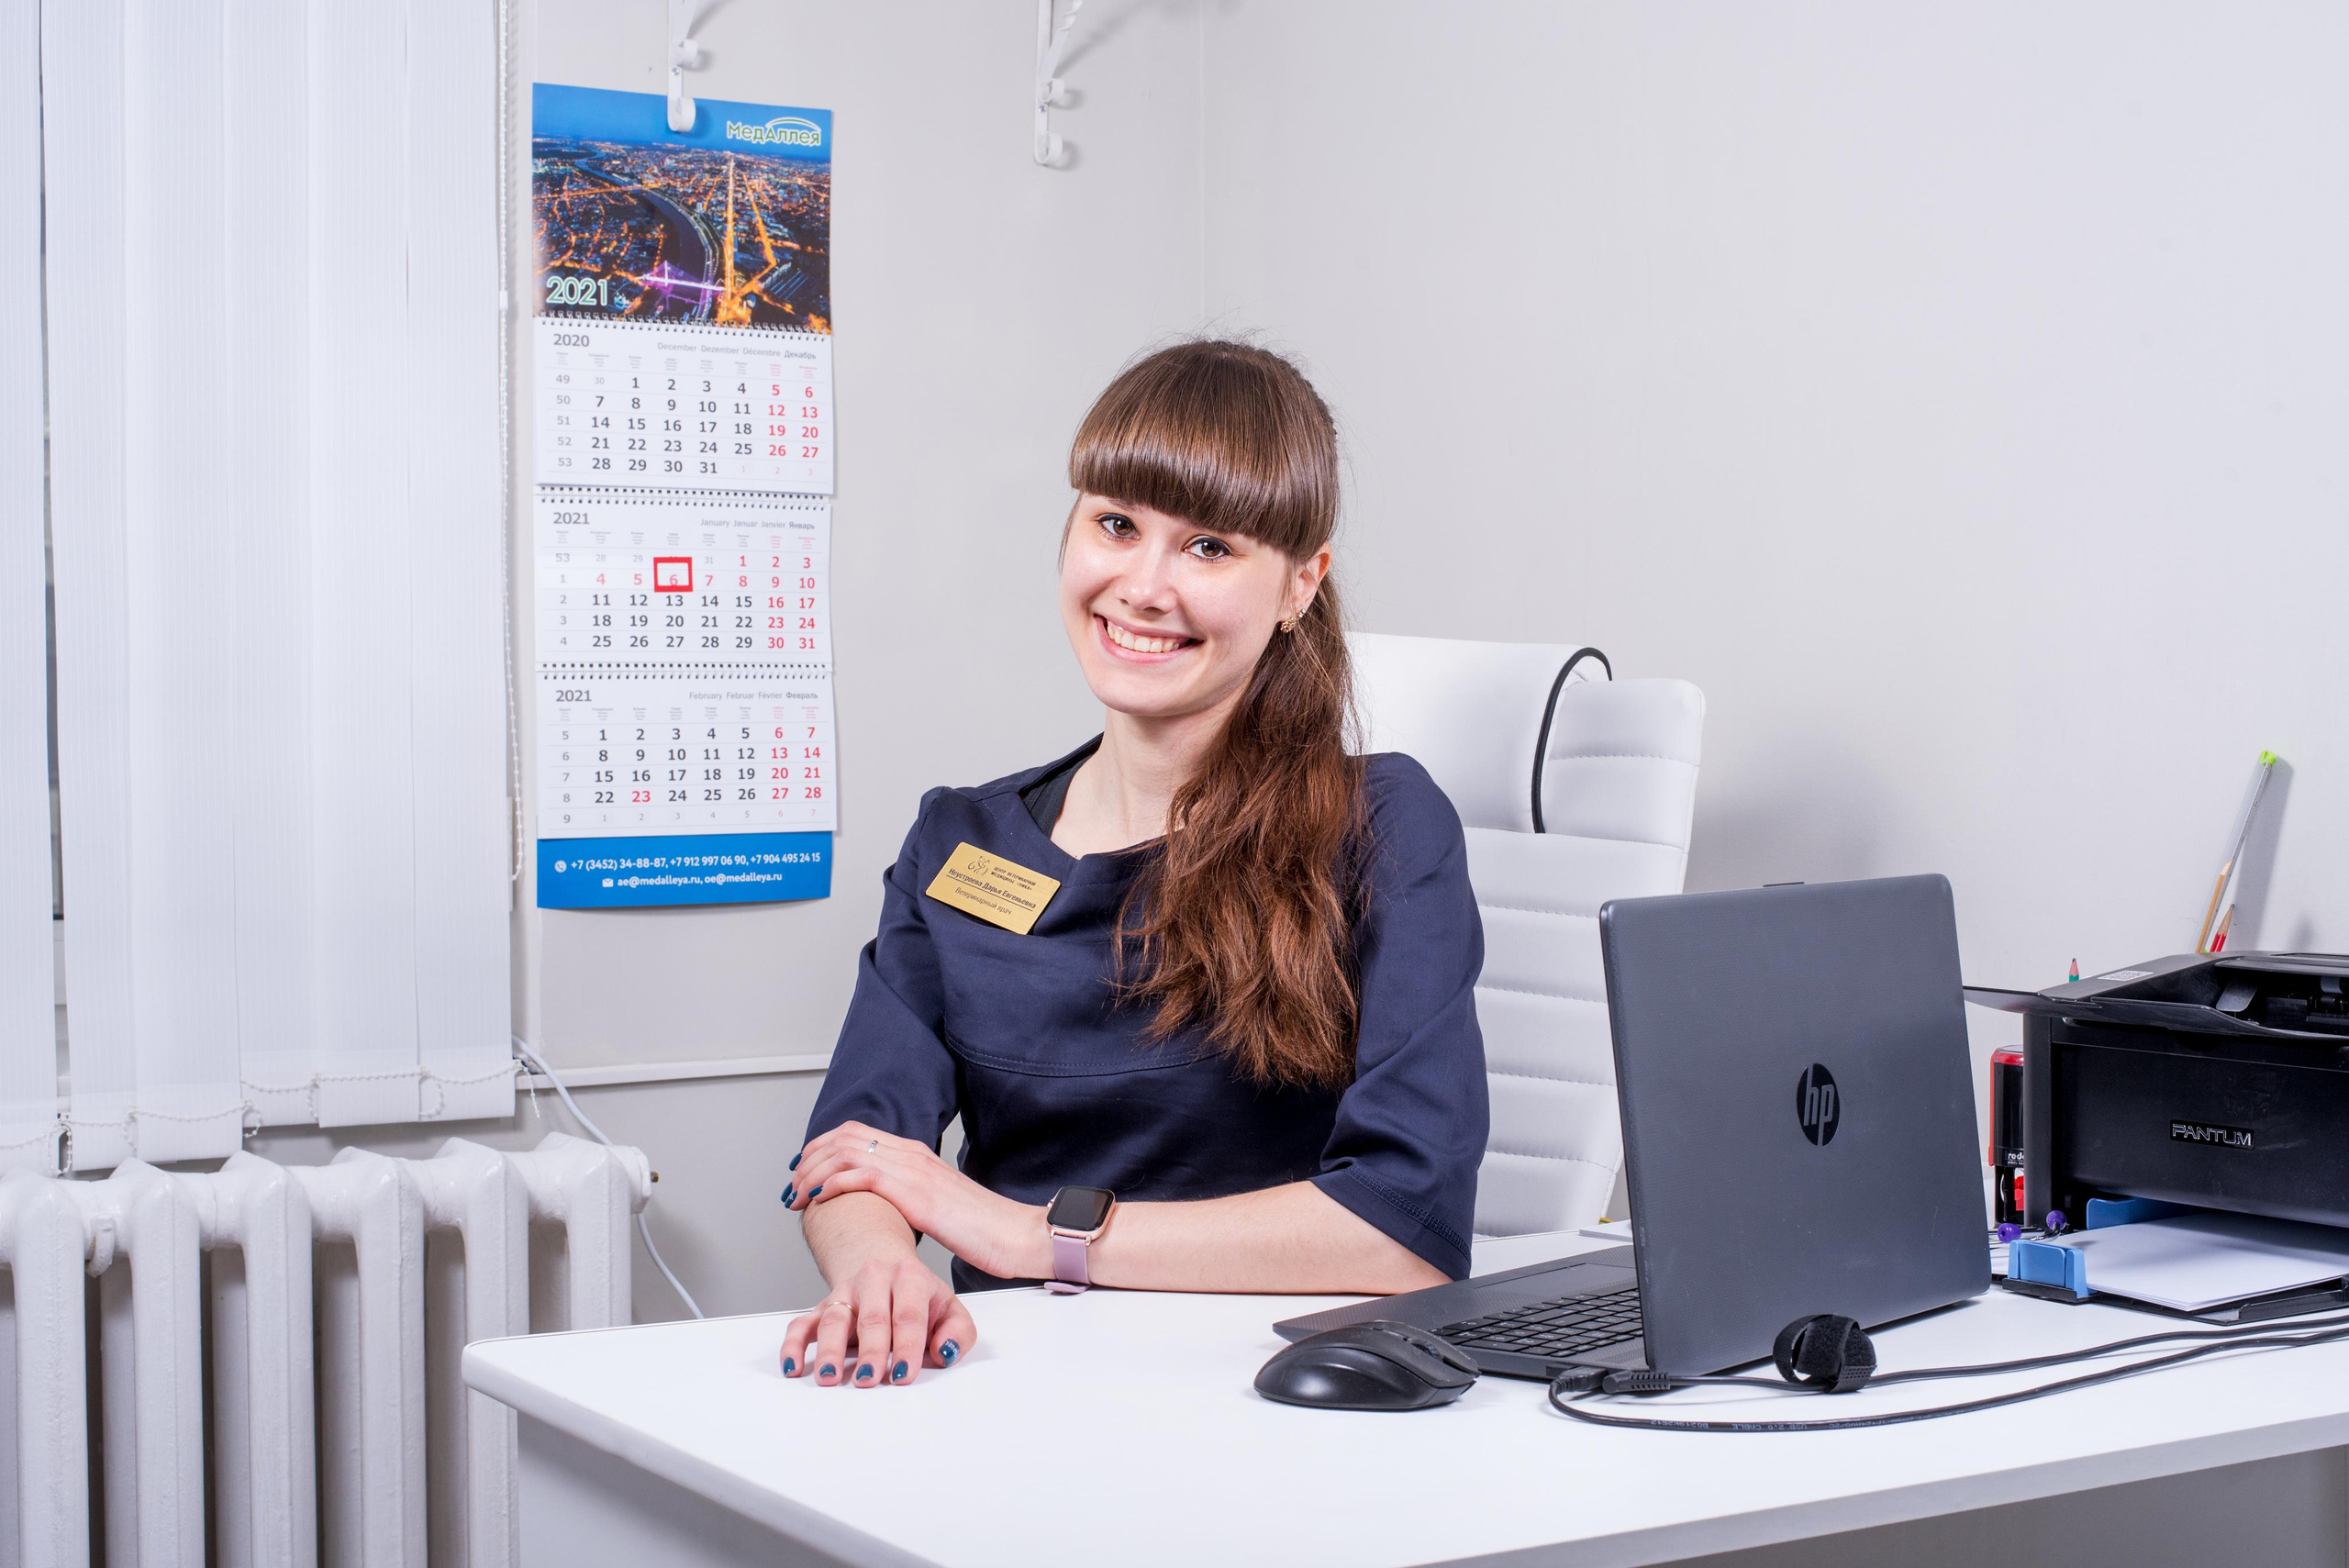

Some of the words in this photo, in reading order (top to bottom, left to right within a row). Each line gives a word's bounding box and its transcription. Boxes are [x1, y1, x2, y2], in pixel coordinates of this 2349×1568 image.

[727, 120, 821, 146] МедАллея
[546, 275, 607, 306] 2021
[553, 333, 590, 348] 2020
[657, 342, 697, 352] December
[700, 344, 740, 355] Dezember
[742, 347, 781, 358] Décembre
[784, 350, 817, 361] Декабрь
[631, 376, 640, 389] 1
[667, 378, 676, 391] 2
[702, 380, 712, 393] 3
[737, 382, 747, 395] 4
[772, 384, 780, 396] 5
[805, 386, 814, 399] 6
[556, 394, 571, 406] 50
[596, 395, 605, 407] 7
[631, 396, 641, 410] 8
[667, 398, 676, 411] 9
[698, 400, 717, 414] 10
[734, 402, 751, 415] 11
[768, 404, 785, 417] 12
[801, 406, 818, 419] 13
[557, 415, 571, 426] 51
[591, 416, 610, 428] 14
[628, 417, 646, 430] 15
[663, 419, 682, 432] 16
[699, 420, 718, 433] 17
[734, 422, 752, 435] 18
[769, 424, 786, 437] 19
[801, 426, 819, 439] 20
[557, 436, 572, 447] 52
[591, 436, 610, 450] 21
[628, 438, 647, 451] 22
[663, 439, 683, 452] 23
[699, 440, 718, 454] 24
[734, 442, 752, 455] 25
[769, 444, 786, 457] 26
[802, 446, 819, 459] 27
[592, 457, 611, 471] 28
[629, 458, 647, 472] 29
[663, 460, 683, 473] 30
[699, 461, 718, 474] 31
[552, 512, 590, 526] 2021
[700, 518, 730, 528] January
[733, 518, 758, 528] Januar
[760, 520, 786, 528] Janvier
[788, 521, 816, 530] Январь
[740, 554, 747, 567] 1
[772, 555, 780, 568] 2
[803, 556, 811, 570] 3
[560, 573, 566, 584] 1
[596, 573, 607, 585] 4
[633, 573, 643, 586] 5
[669, 573, 679, 586] 6
[705, 574, 714, 587] 7
[739, 574, 748, 588] 8
[771, 575, 780, 588] 9
[799, 577, 816, 590] 10
[560, 594, 567, 605] 2
[592, 594, 611, 606] 11
[629, 594, 649, 606] 12
[665, 595, 684, 607] 13
[701, 595, 719, 607] 14
[735, 595, 752, 608] 15
[768, 596, 785, 609] 16
[799, 596, 815, 609] 17
[560, 615, 567, 626] 3
[592, 614, 612, 628] 18
[629, 614, 649, 628] 19
[665, 615, 685, 628] 20
[700, 615, 718, 628] 21
[735, 616, 753, 628] 22
[767, 616, 785, 629] 23
[798, 617, 816, 629] 24
[560, 636, 568, 646] 4
[592, 635, 612, 648] 25
[629, 635, 649, 648] 26
[665, 635, 685, 648] 27
[701, 636, 719, 649] 28
[735, 636, 752, 649] 29
[767, 636, 785, 650] 30
[798, 637, 816, 650] 31
[555, 689, 593, 703] 2021
[689, 691, 723, 702] February
[726, 691, 755, 700] Februar
[758, 691, 783, 700] Février
[785, 691, 818, 700] Февраль
[562, 730, 570, 740] 5
[599, 728, 607, 741] 1
[636, 728, 645, 740] 2
[672, 728, 681, 740] 3
[707, 728, 717, 740] 4
[741, 727, 751, 740] 5
[774, 727, 784, 740] 6
[807, 726, 816, 739] 7
[562, 751, 570, 762] 6
[598, 749, 608, 762] 8
[635, 749, 645, 762] 9
[668, 748, 686, 761] 10
[703, 748, 721, 761] 11
[738, 747, 755, 760] 12
[771, 747, 788, 760] 13
[804, 746, 821, 759] 14
[562, 772, 571, 783] 7
[595, 770, 614, 783] 15
[631, 769, 651, 783] 16
[668, 769, 687, 782] 17
[704, 768, 722, 781] 18
[738, 767, 755, 780] 19
[771, 767, 789, 780] 20
[804, 766, 820, 779] 21
[562, 793, 571, 804] 8
[595, 791, 615, 804] 22
[631, 790, 651, 803] 23
[668, 789, 687, 802] 24
[704, 788, 722, 801] 25
[738, 787, 756, 800] 26
[772, 787, 789, 800] 27
[804, 786, 822, 799] 28
[562, 814, 571, 824] 9
[571, 860, 584, 870] +7
[585, 859, 618, 872] (3452)
[619, 857, 669, 869] 34-88-87,
[670, 856, 683, 867] +7
[684, 856, 700, 867] 912
[701, 855, 719, 866] 997
[720, 855, 733, 865] 06
[734, 855, 750, 866] 90,
[751, 854, 763, 864] +7
[763, 853, 781, 864] 904
[781, 853, 798, 863] 495
[799, 852, 811, 862] 24
[811, 852, 821, 862] 15
[617, 874, 704, 888] ae@medalleya.ru,
[704, 872, 783, 885] oe@medalleya.ru
[948, 868, 983, 887] Неустроева
[982, 881, 1003, 896] Дарья
[1002, 890, 1037, 909] Евгеньевна
[954, 886, 997, 910] Ветеринарный
[996, 903, 1012, 916] врач
[1803, 1063, 1835, 1147] hp
[2172, 1123, 2252, 1147] PANTUM
